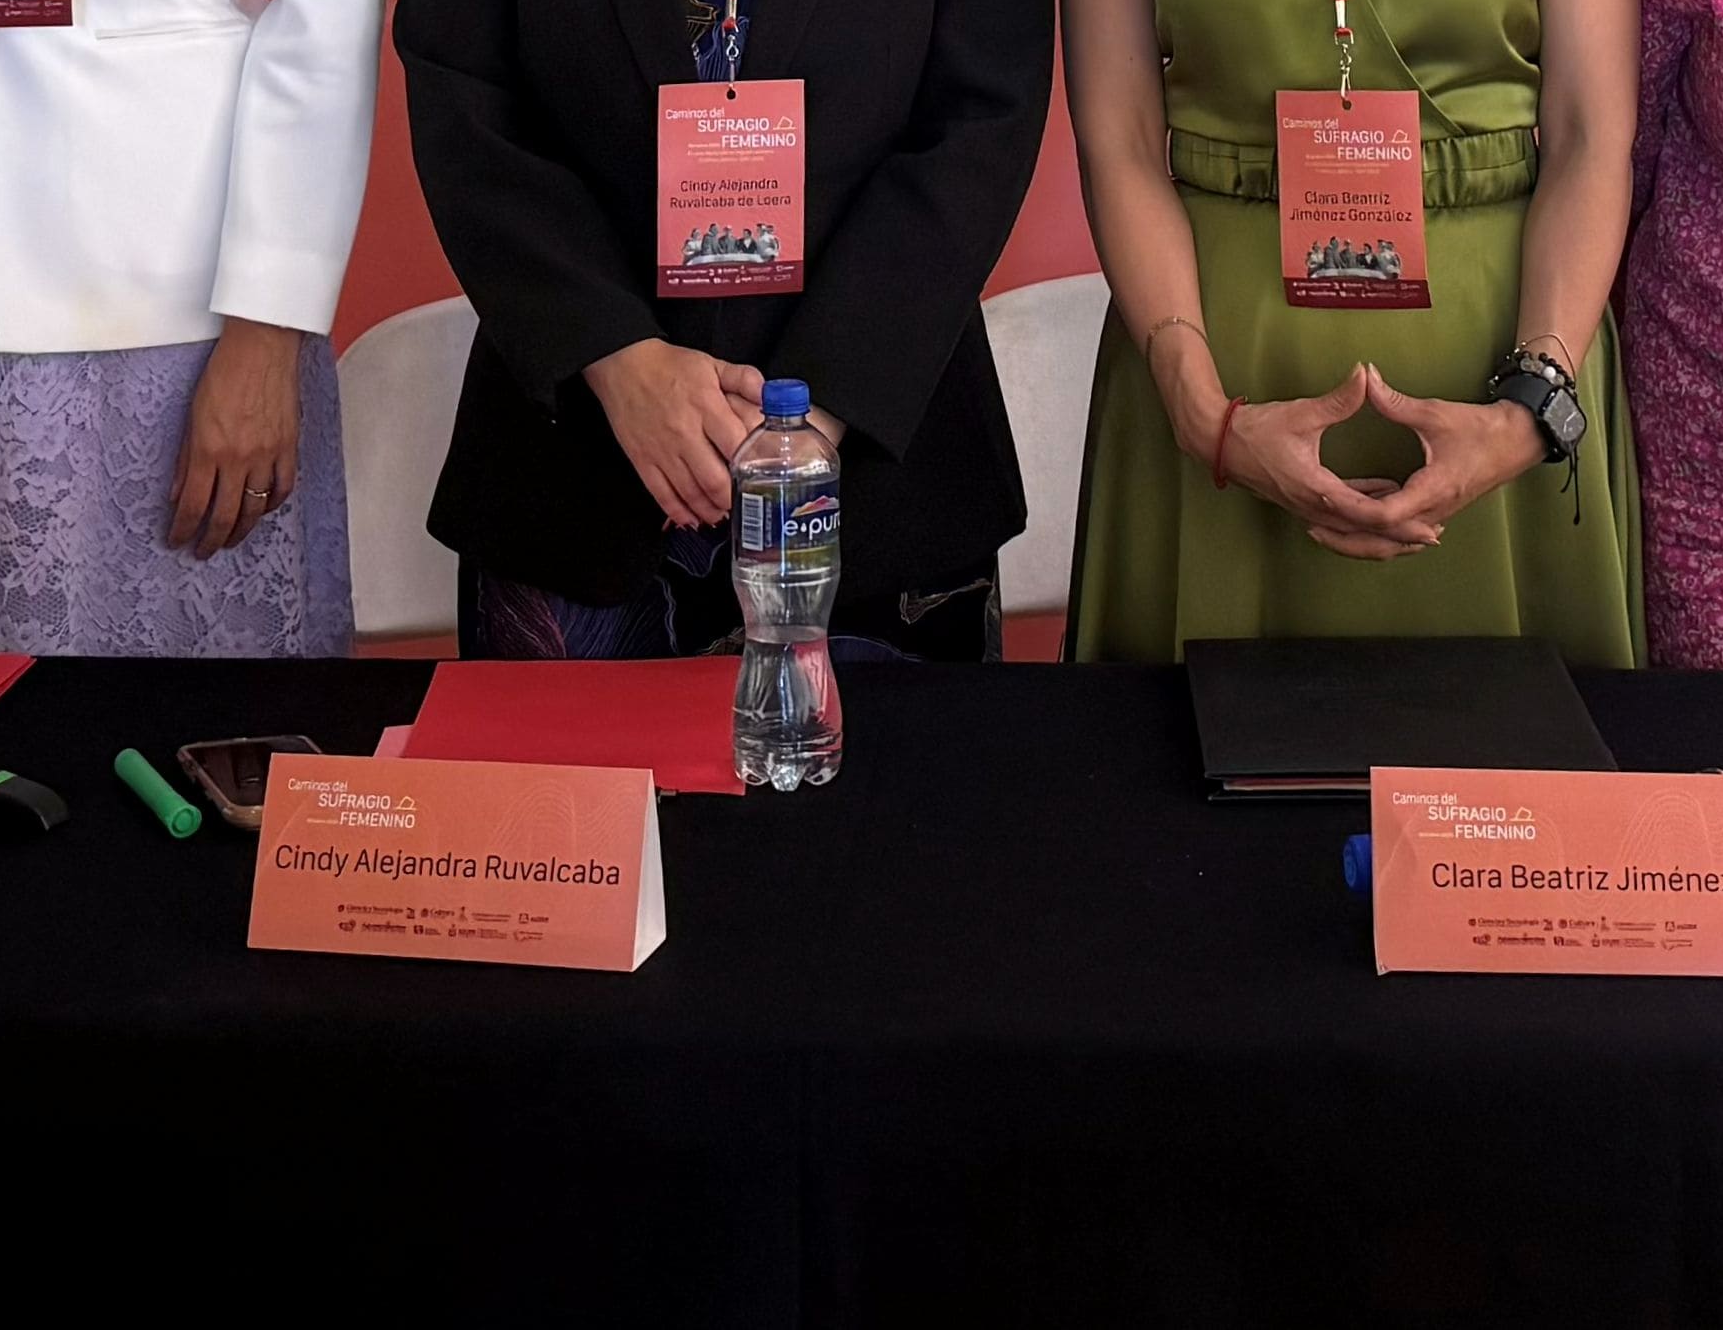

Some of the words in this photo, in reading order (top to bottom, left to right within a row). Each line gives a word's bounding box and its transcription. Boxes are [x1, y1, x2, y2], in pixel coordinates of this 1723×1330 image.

[709, 108, 725, 118] del
[697, 118, 770, 133] SUFRAGIO
[721, 133, 796, 148] FEMENINO
[1313, 130, 1384, 144] SUFRAGIO
[1337, 146, 1412, 161] FEMENINO
[680, 180, 716, 195] Cindy
[718, 178, 778, 192] Alejandra
[670, 196, 735, 209] Ruvalcaba
[737, 196, 753, 207] de
[1304, 191, 1339, 204] Clara
[1342, 191, 1391, 205] Beatriz
[1289, 207, 1346, 222] Jiménez
[331, 781, 348, 792] del
[318, 793, 391, 810] SUFRAGIO
[1441, 793, 1457, 805] del
[340, 812, 415, 829] FEMENINO
[1428, 806, 1507, 821] SUFRAGIO
[1455, 824, 1536, 839] FEMENINO
[276, 845, 350, 878] Cindy
[354, 848, 477, 881] Alejandra
[485, 855, 620, 885] Ruvalcaba
[1432, 862, 1502, 889] Clara
[1511, 865, 1610, 891] Beatriz
